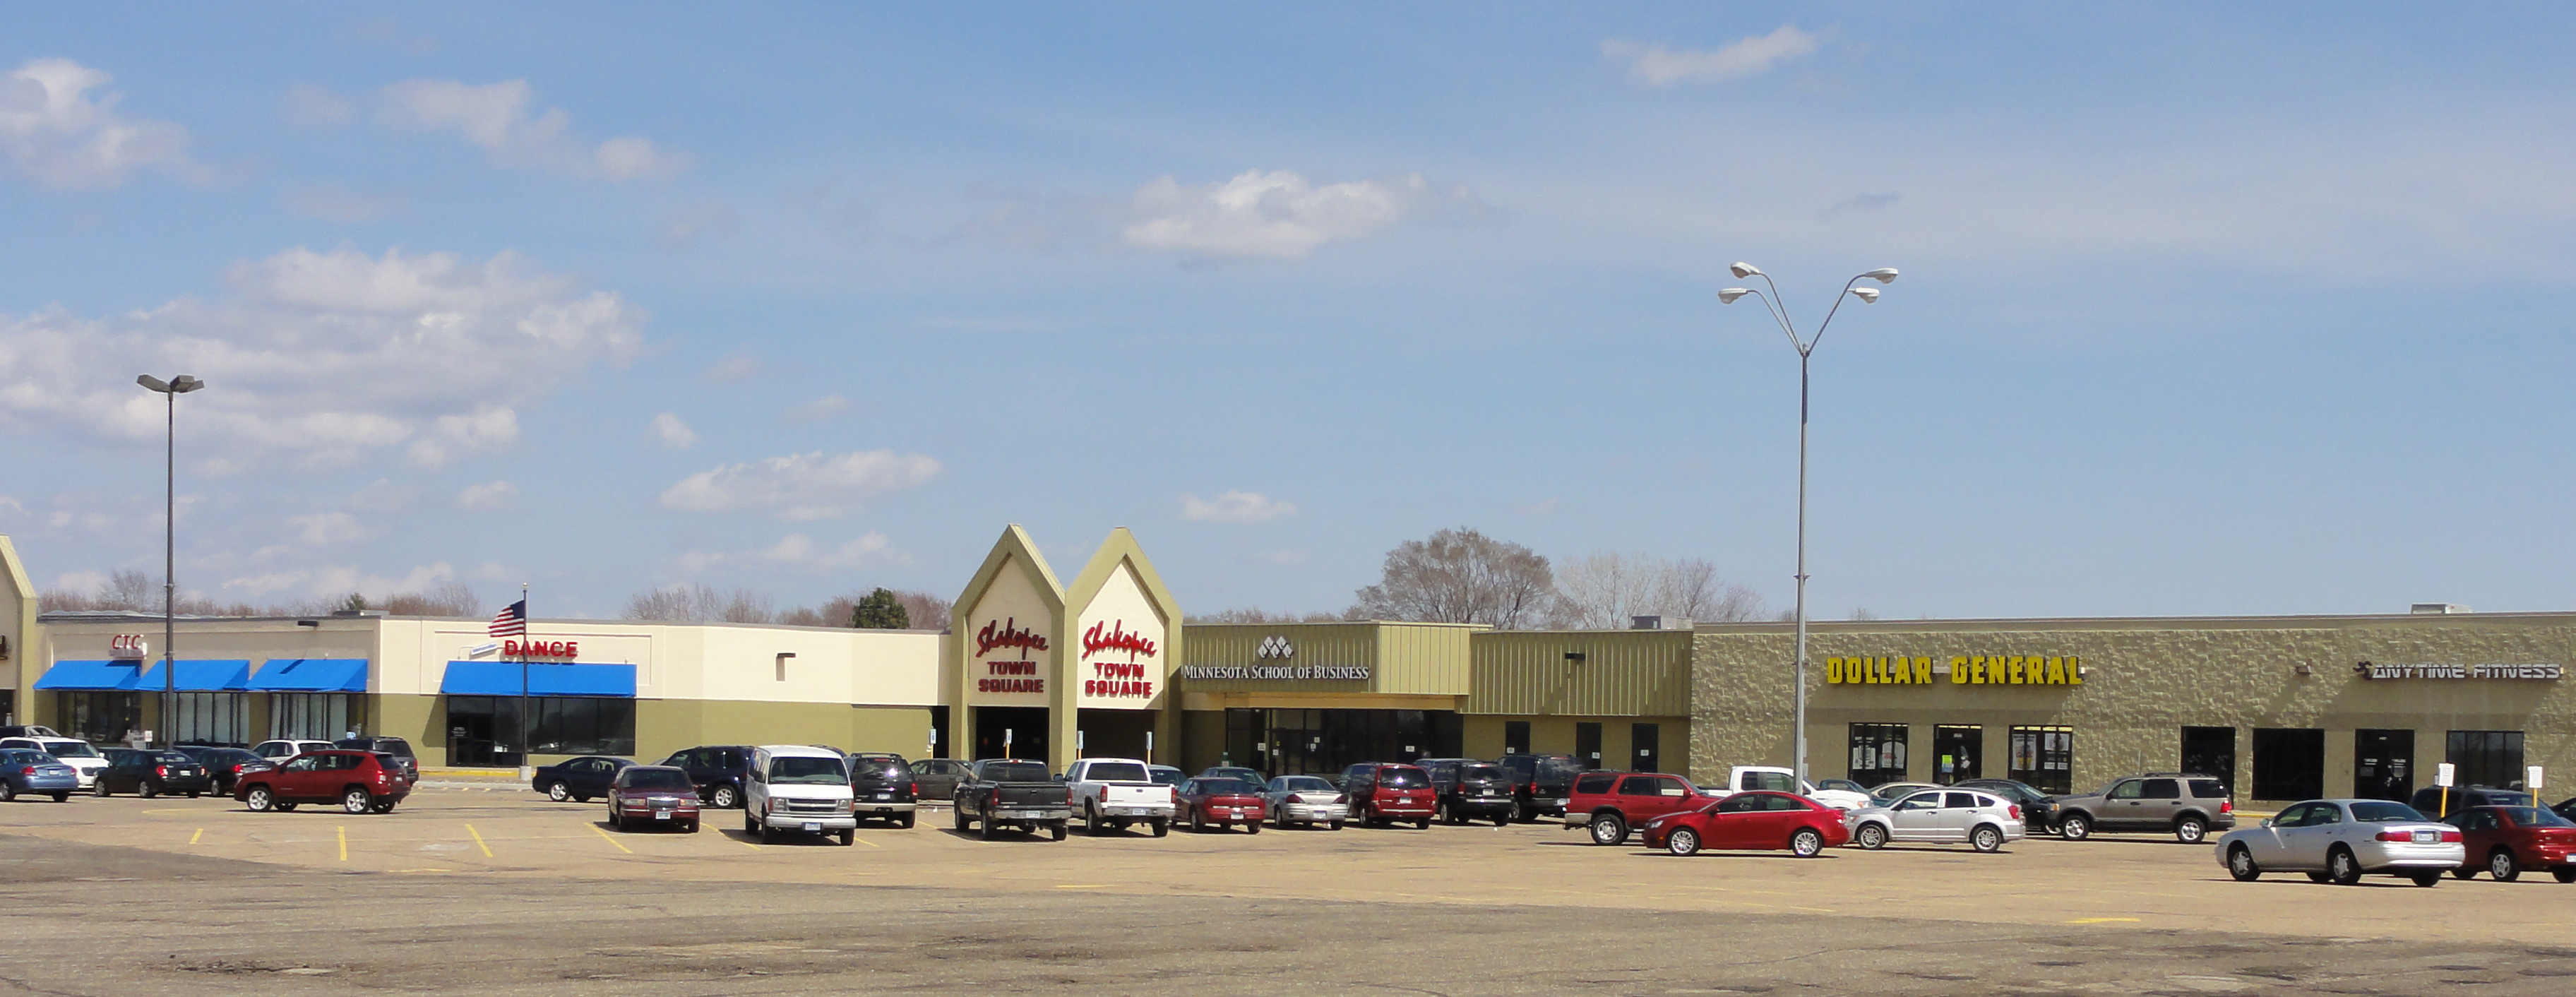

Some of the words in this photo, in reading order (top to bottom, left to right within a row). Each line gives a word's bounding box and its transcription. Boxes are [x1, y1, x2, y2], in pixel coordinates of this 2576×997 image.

[975, 616, 1049, 660] Shakopee
[1082, 619, 1157, 662] Shakopee
[504, 640, 578, 657] DANCE
[987, 661, 1037, 675] TOWN
[1094, 662, 1145, 678] TOWN
[1184, 664, 1249, 679] MINNESOTA
[1252, 665, 1294, 679] SCHOOL
[1313, 665, 1369, 679] BUSINESS
[1827, 657, 1932, 684] DOLLAR
[1951, 656, 2082, 685] GENERAL
[2372, 663, 2465, 679] ANYTIME
[2472, 663, 2560, 679] FITNESS
[977, 679, 1044, 693] SQUARE
[1085, 680, 1152, 695] SQUARE
